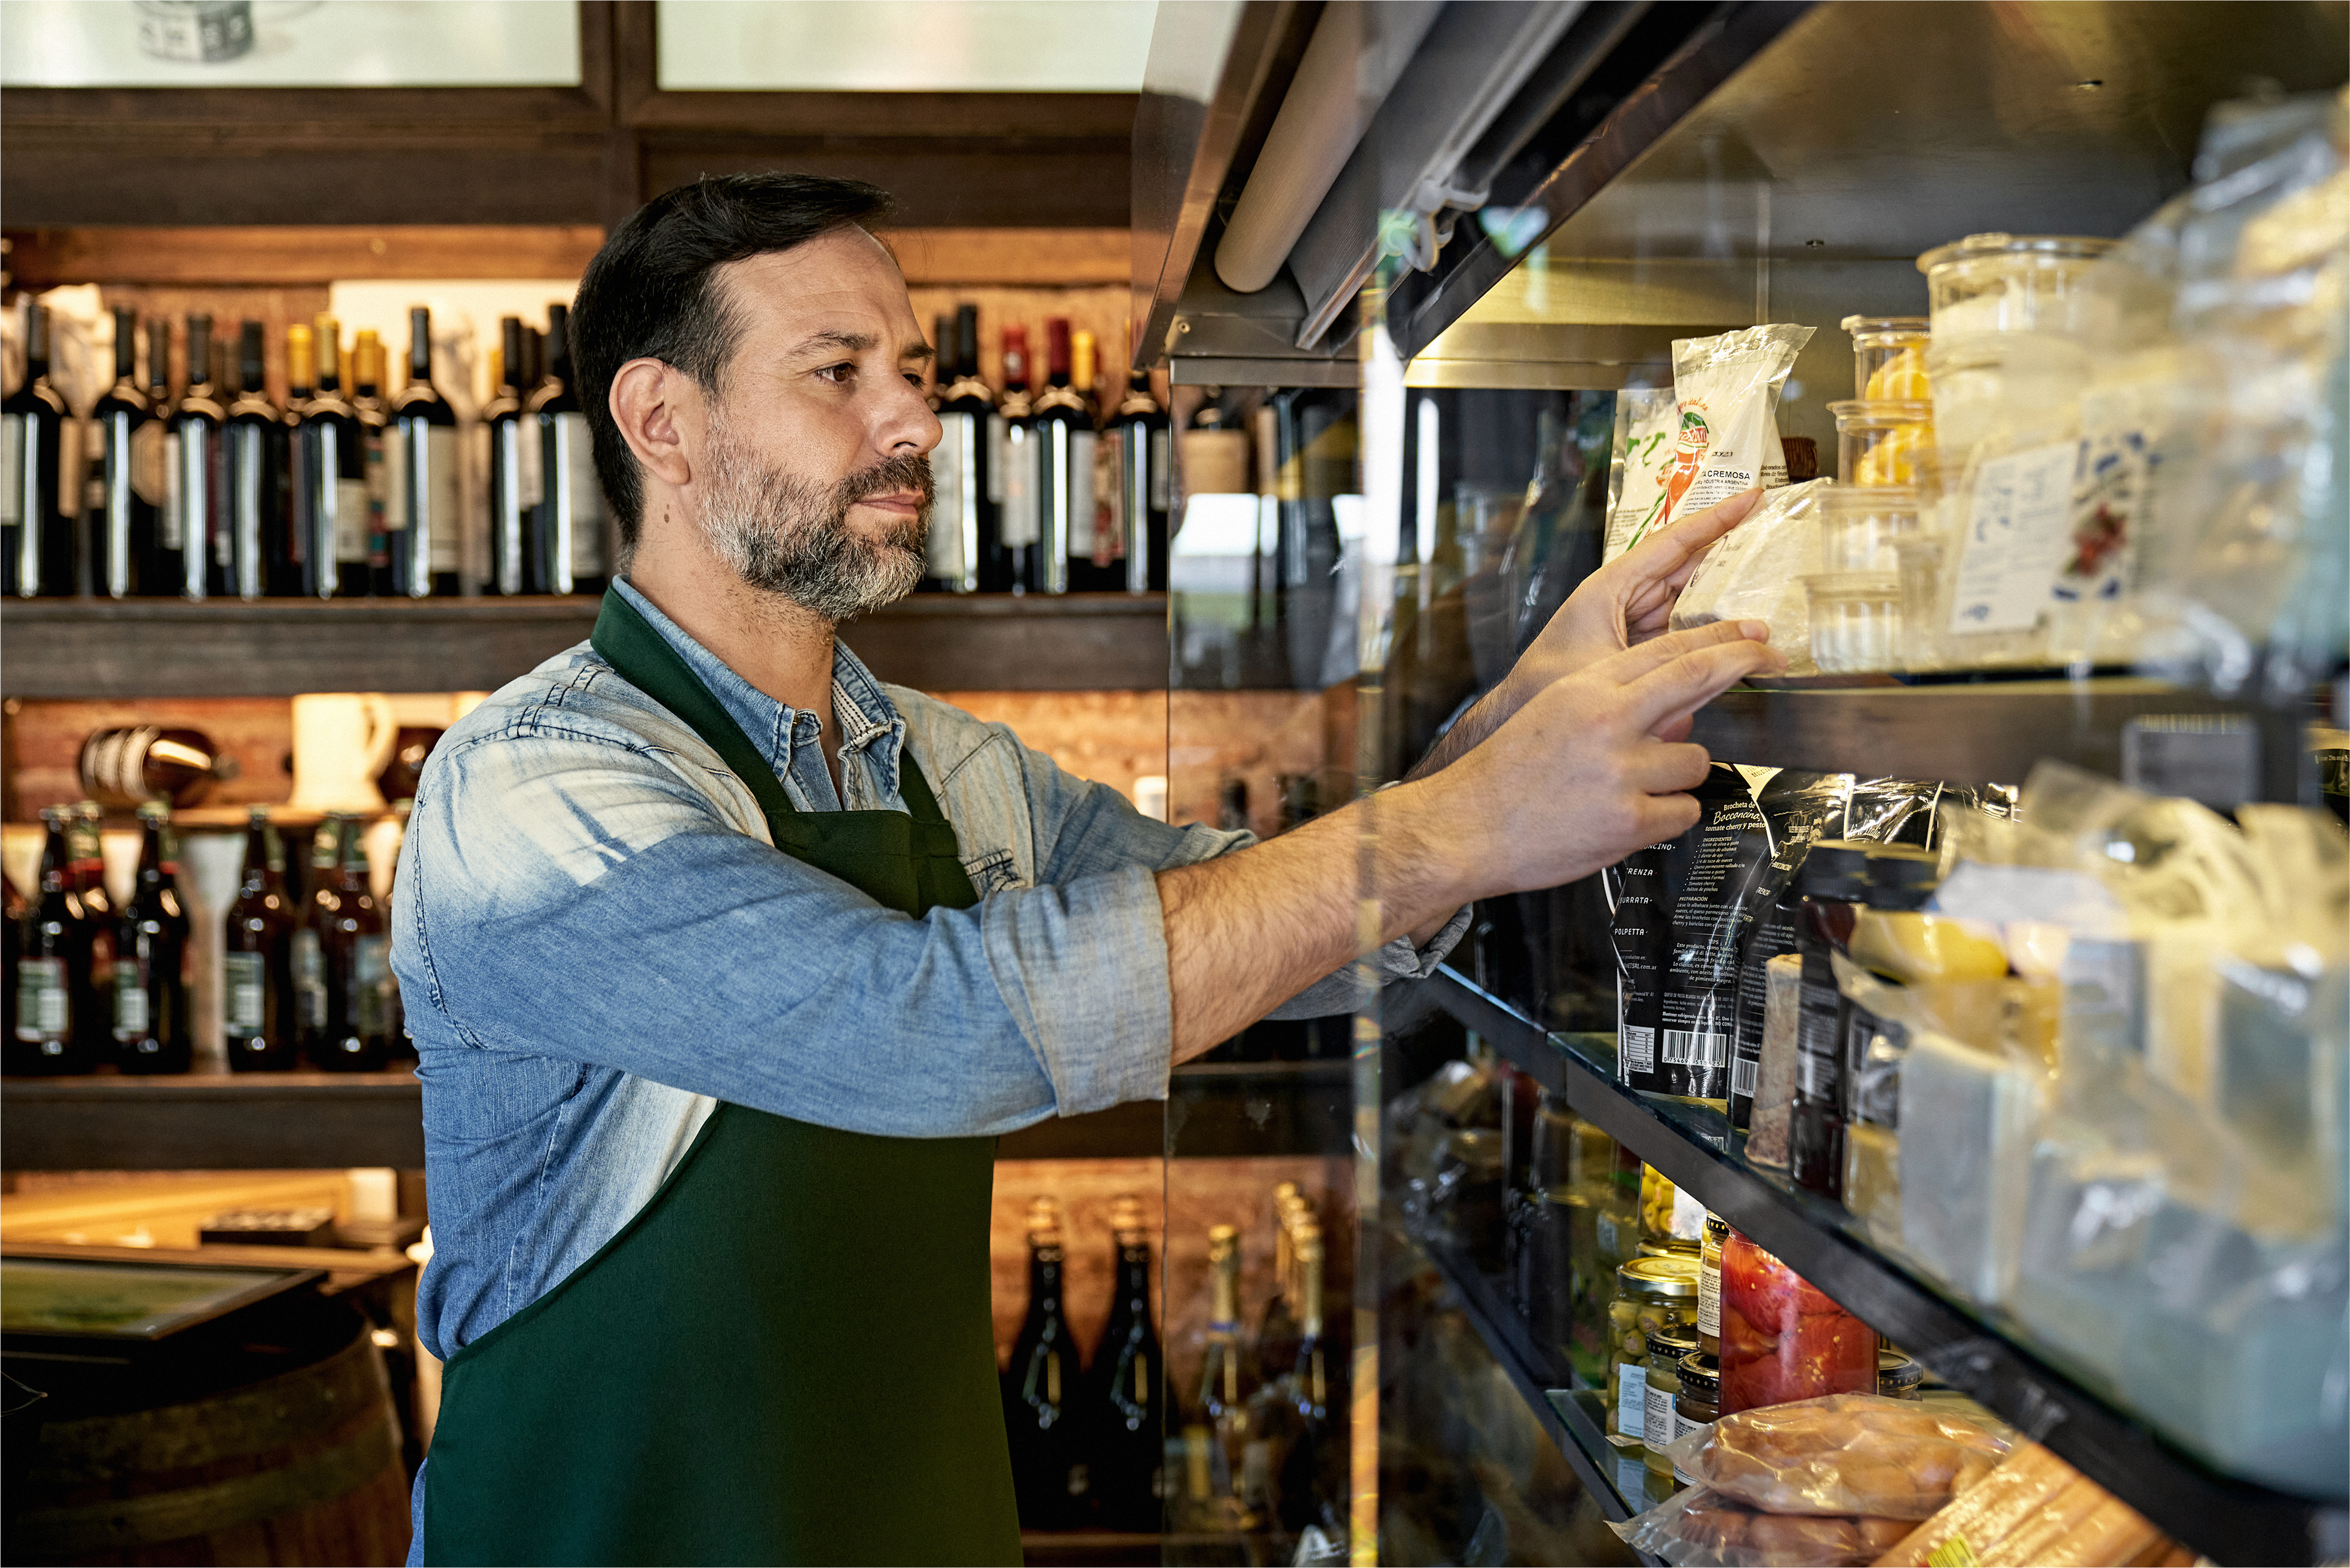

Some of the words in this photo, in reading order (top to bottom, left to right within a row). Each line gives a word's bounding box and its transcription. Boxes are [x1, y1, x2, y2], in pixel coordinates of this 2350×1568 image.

[1708, 470, 1750, 479] CREMOSA
[1724, 802, 1747, 812] Brocheta
[1748, 822, 1766, 830] pesto
